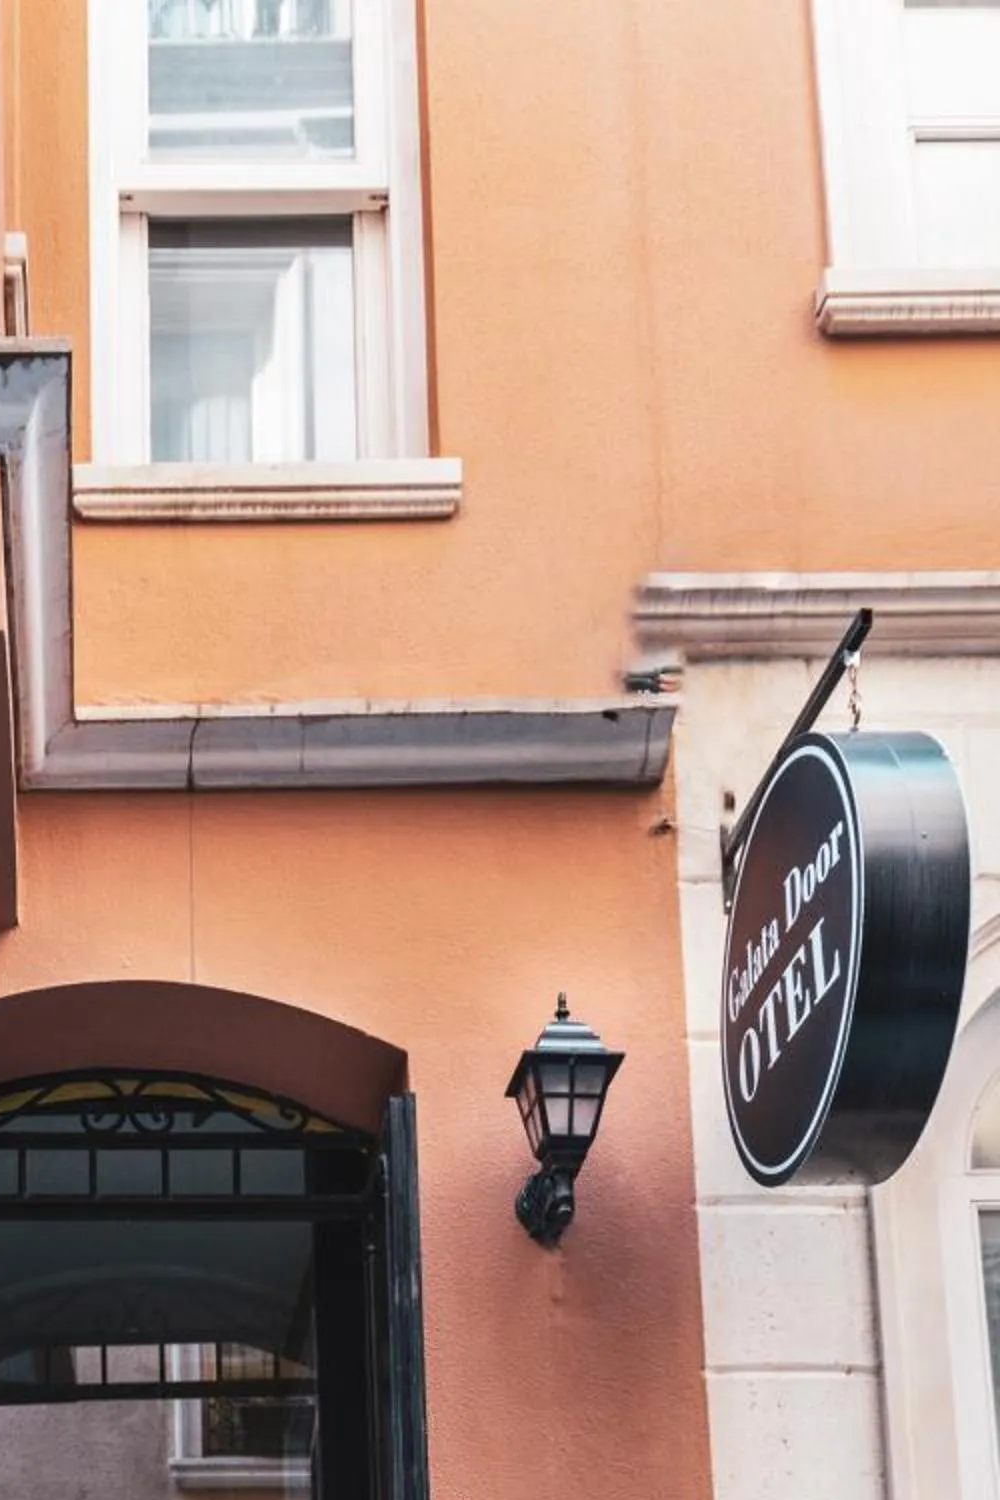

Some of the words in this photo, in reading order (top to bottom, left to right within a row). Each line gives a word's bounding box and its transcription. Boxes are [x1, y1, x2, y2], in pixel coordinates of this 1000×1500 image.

[728, 918, 781, 1023] Galata
[784, 820, 844, 934] Door
[739, 917, 841, 1103] OTEL
